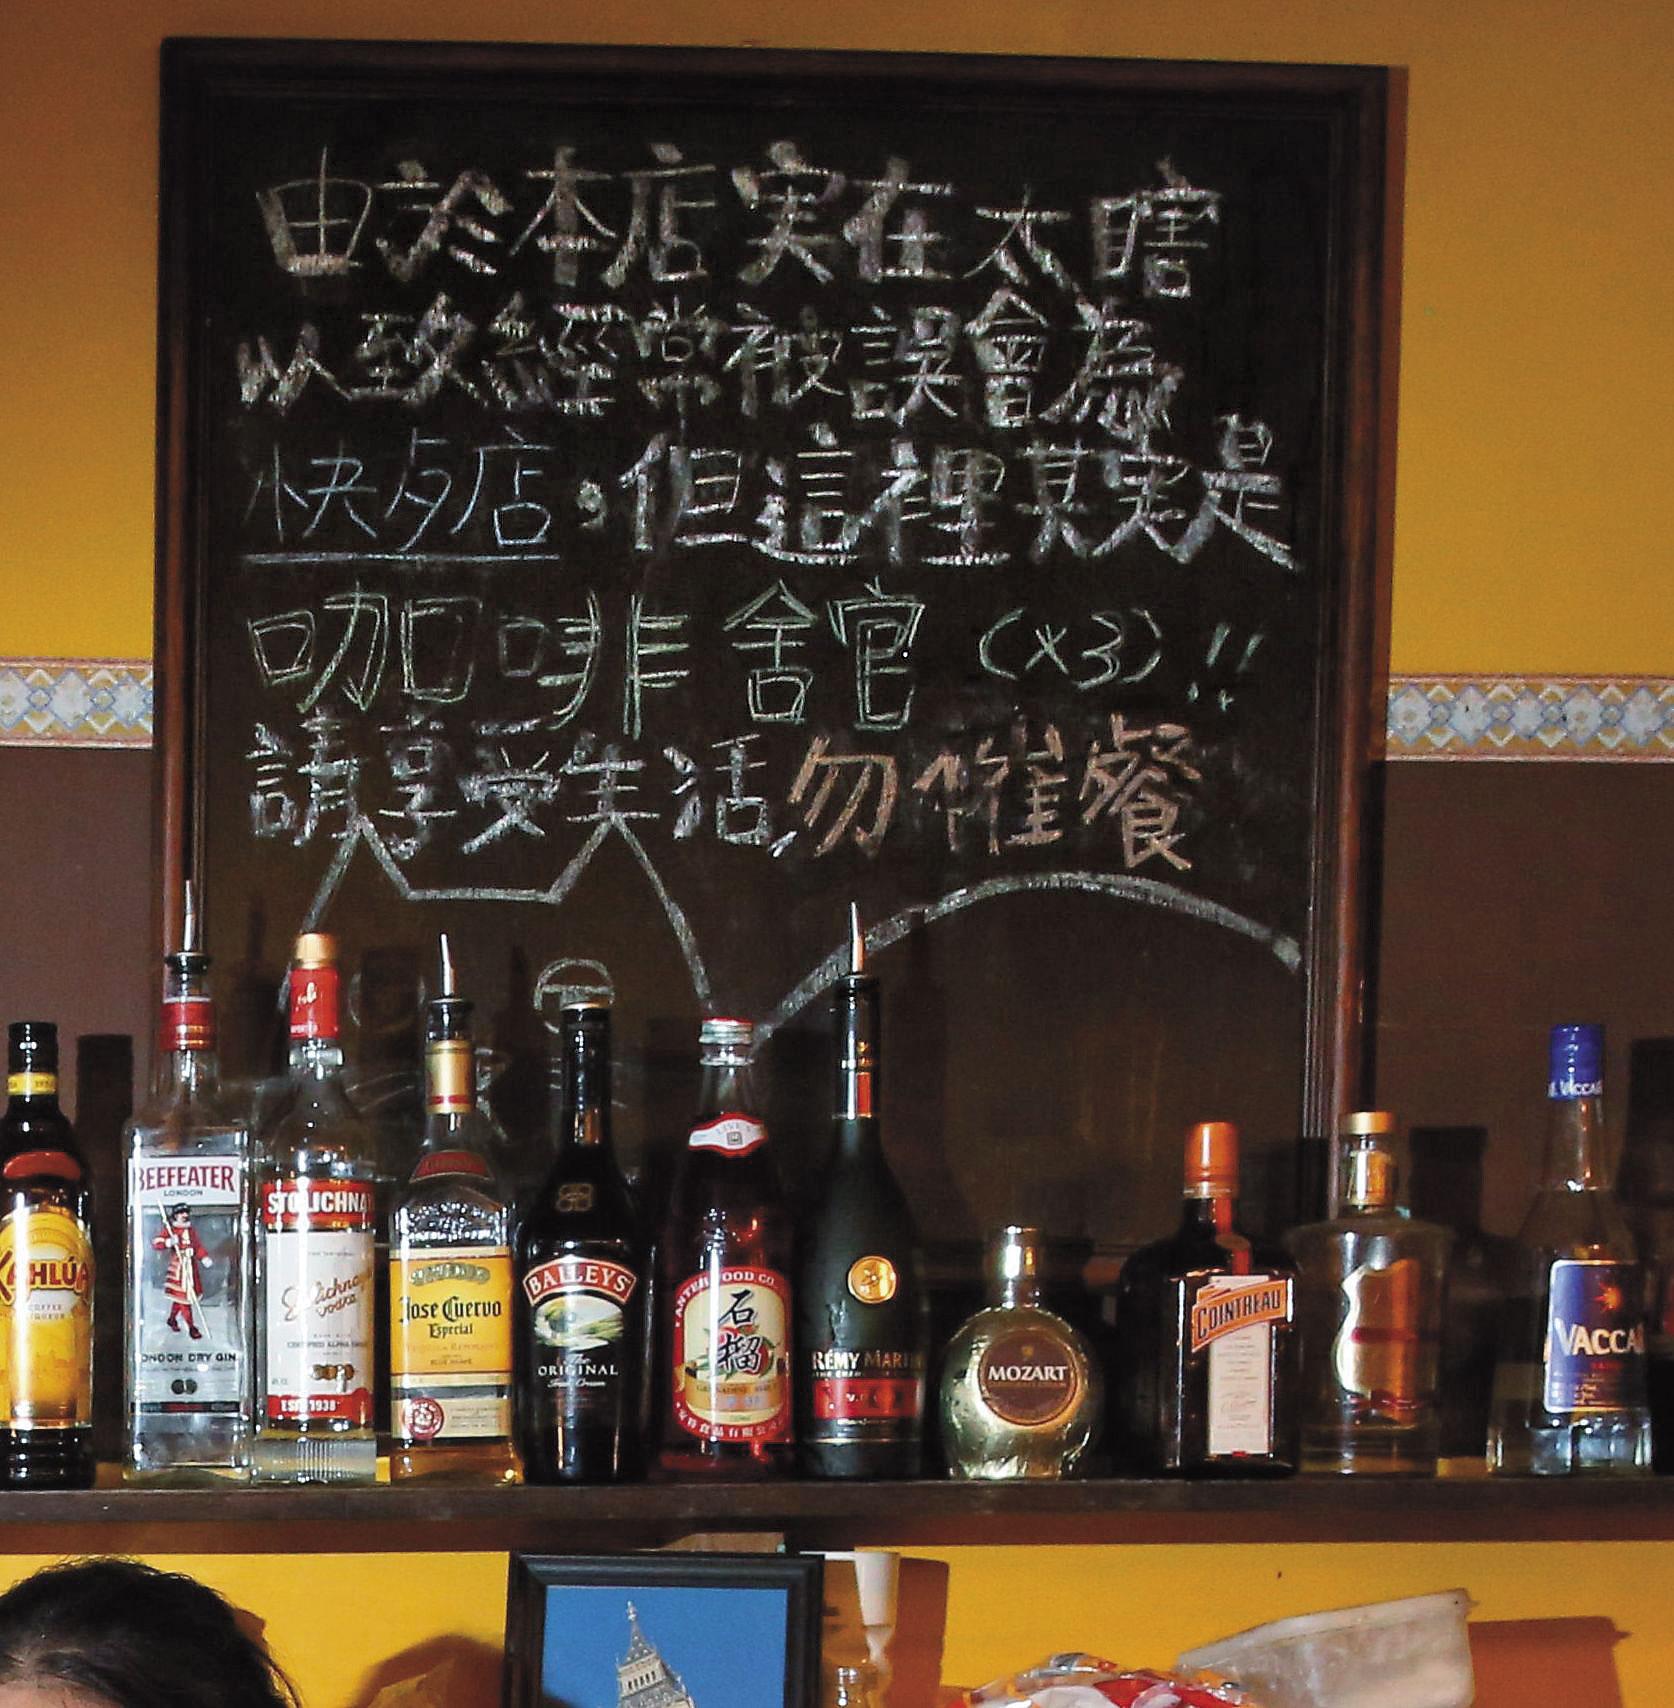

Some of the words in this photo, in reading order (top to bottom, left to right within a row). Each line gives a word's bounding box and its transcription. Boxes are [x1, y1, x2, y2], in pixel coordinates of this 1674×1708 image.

[138, 1164, 237, 1194] BEEFEATER
[163, 1189, 203, 1197] LONDON
[528, 1263, 631, 1296] BAILEYS
[399, 1296, 439, 1323] Jose
[442, 1296, 503, 1323] Cuervo
[1196, 1289, 1281, 1340] COINTREAU
[428, 1323, 474, 1340] Especial
[718, 1288, 763, 1376] 石榴
[141, 1352, 184, 1363] ONDON
[188, 1352, 213, 1363] DRY
[216, 1352, 237, 1363] GIN
[812, 1348, 860, 1370] RÉMY
[537, 1365, 619, 1378] ORIGINAL
[988, 1365, 1069, 1382] MOZART
